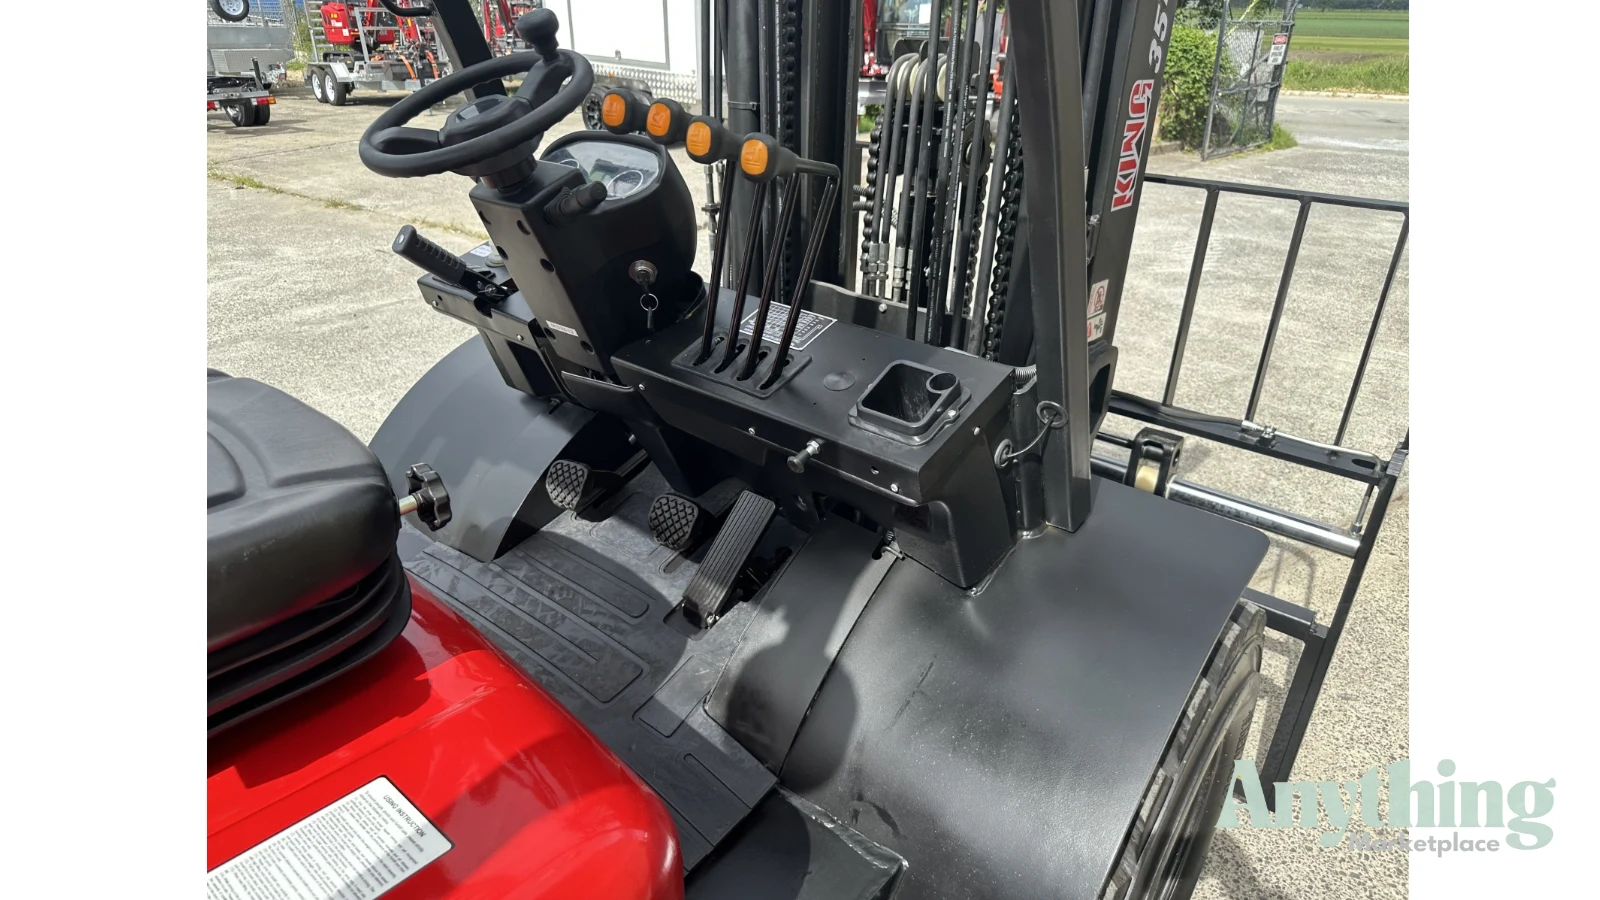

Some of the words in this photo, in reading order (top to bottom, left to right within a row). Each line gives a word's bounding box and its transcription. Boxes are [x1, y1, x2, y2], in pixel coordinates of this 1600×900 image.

[1111, 79, 1155, 212] KING
[1148, 0, 1169, 74] 35
[383, 794, 399, 809] USING
[396, 807, 427, 837] INSTRUCTION
